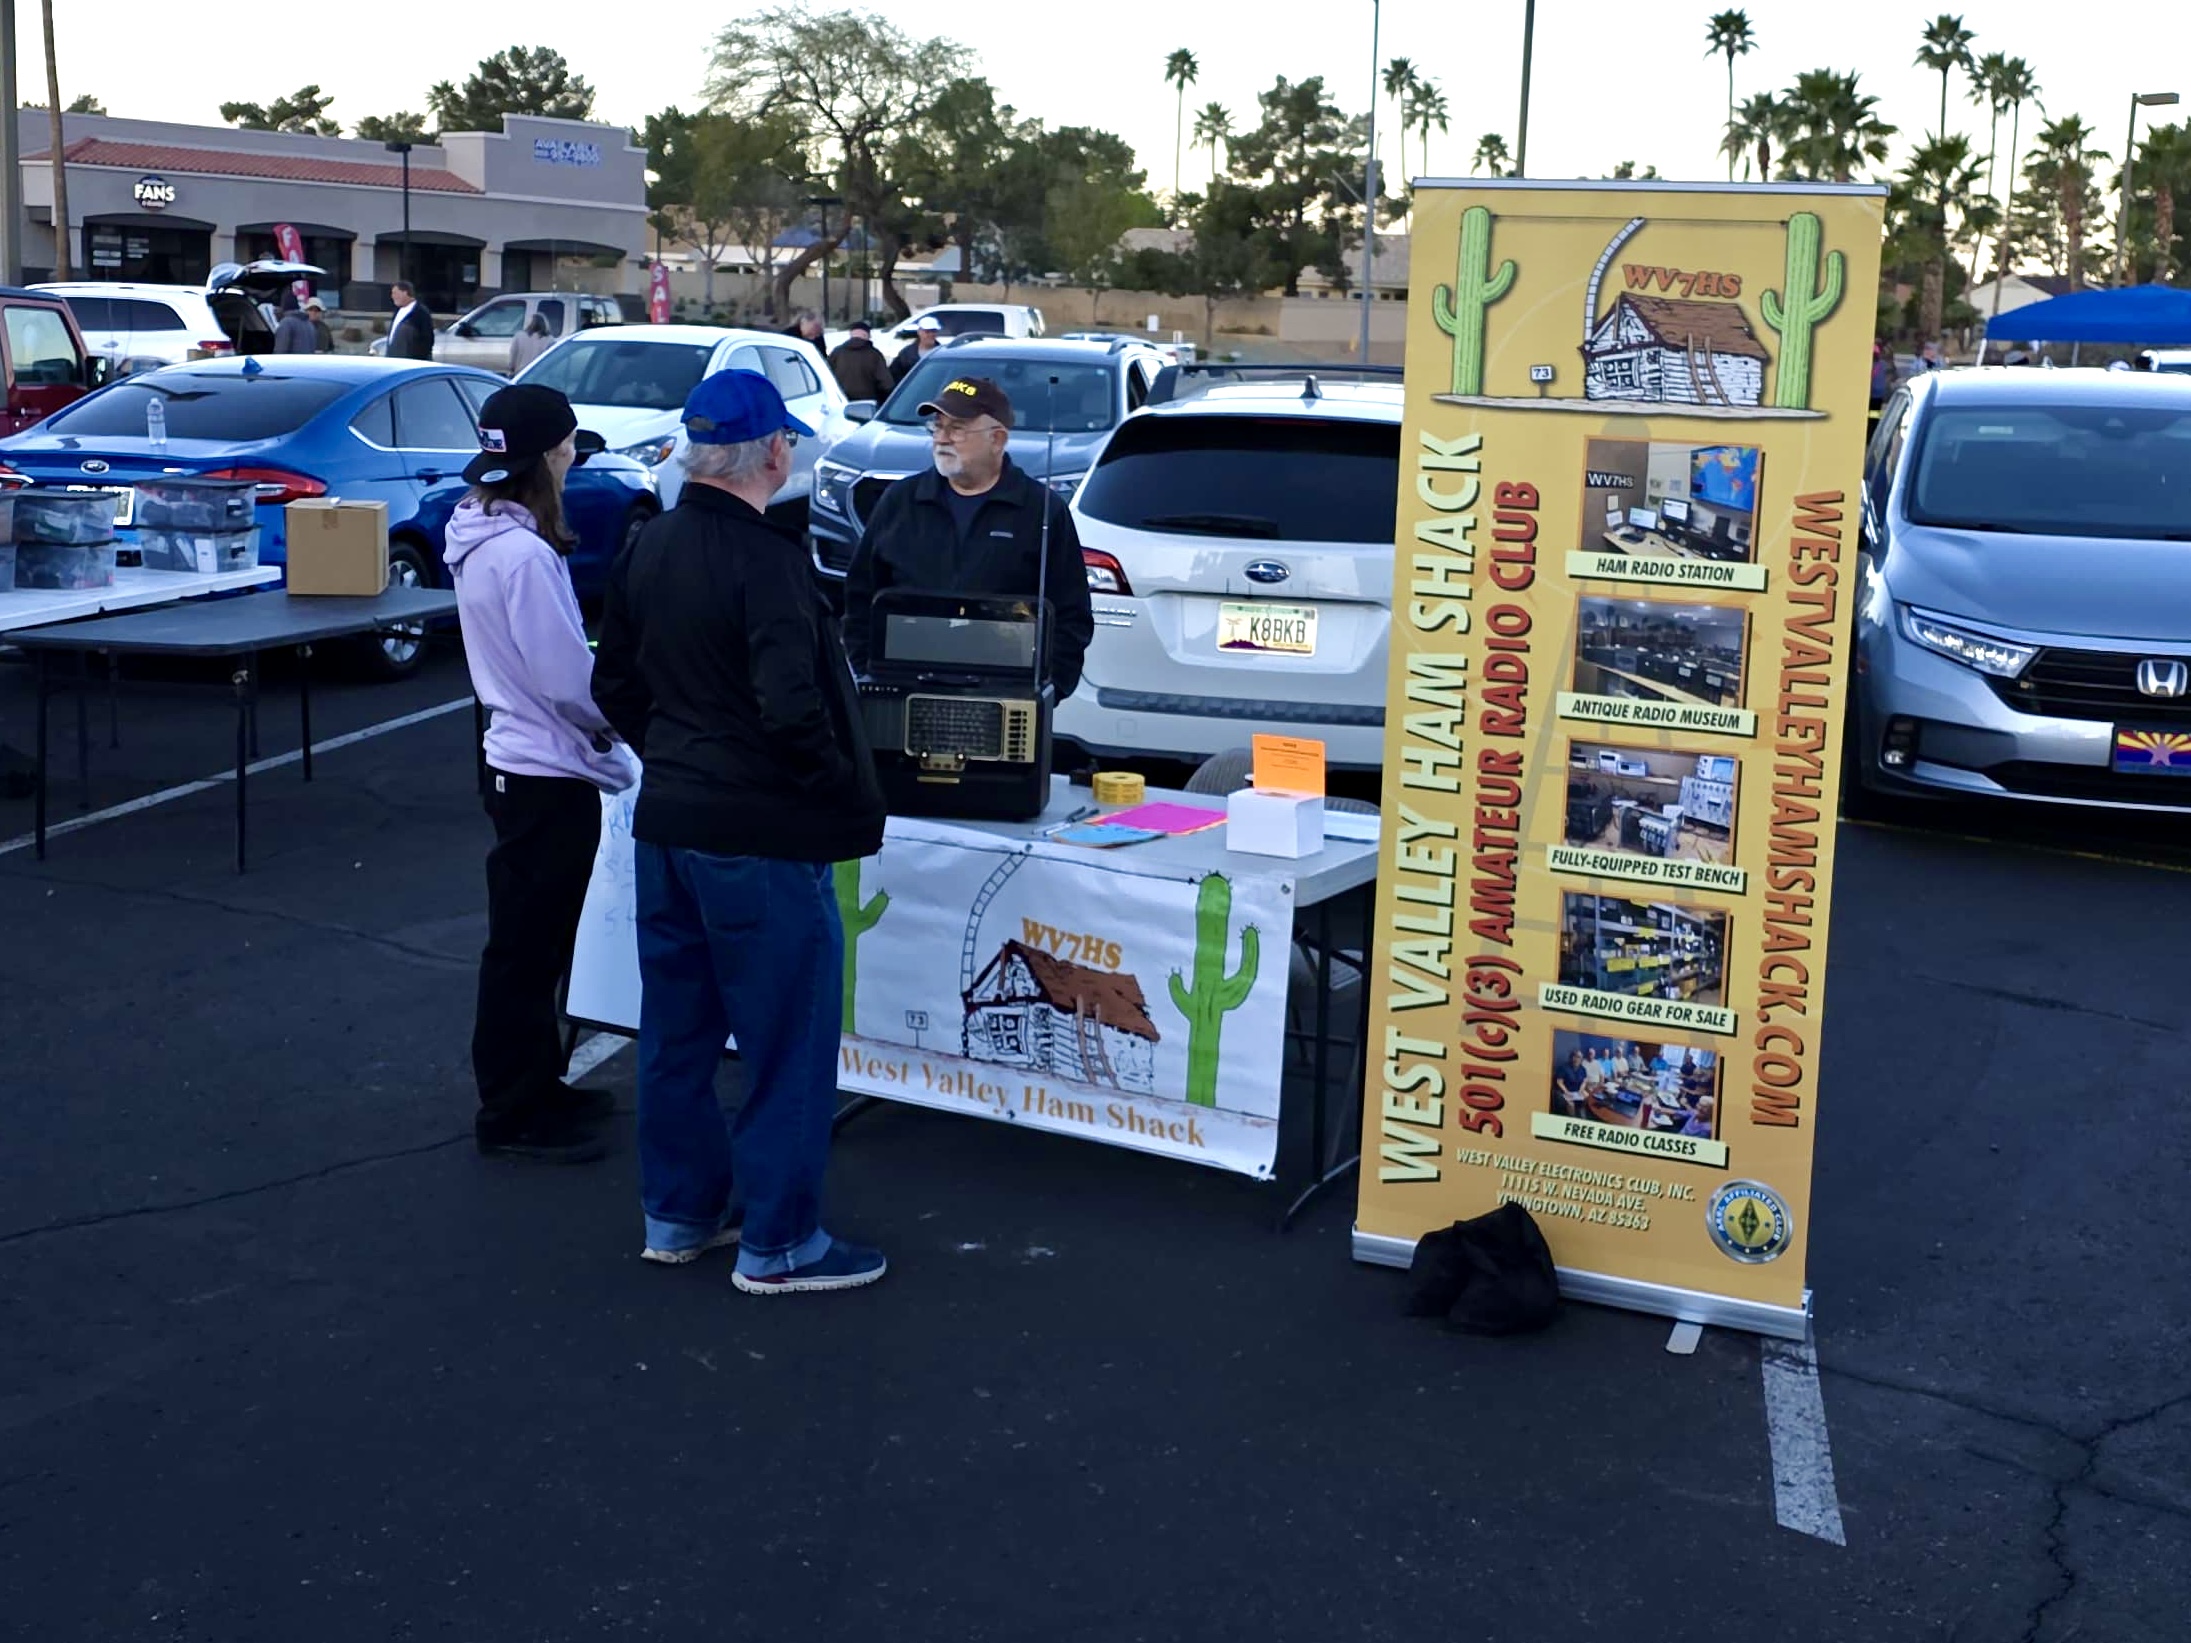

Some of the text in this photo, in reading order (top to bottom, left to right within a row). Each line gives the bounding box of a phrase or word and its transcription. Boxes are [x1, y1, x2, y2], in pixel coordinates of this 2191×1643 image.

[134, 184, 175, 201] FANS
[1622, 264, 1742, 298] WV7HS
[1533, 369, 1549, 379] 73
[1587, 472, 1634, 488] WV7HS
[1596, 558, 1735, 582] HAM RADIO STATION
[1250, 617, 1306, 643] K8BKB
[1571, 699, 1740, 729] ANTIQUE RADIO MUSEUM
[1378, 429, 1483, 1183] WEST VALLEY HAM SHACK
[1458, 481, 1540, 1138] 501(c)(3) AMATEUR RADIO CLUB
[1750, 490, 1845, 1128] WESTVALLEYHAMSHACK.COM
[1551, 850, 1740, 886] FULLY-EQUIPPED TEST BENCH
[1022, 917, 1123, 969] WV7HS
[1545, 988, 1727, 1027] USED RADIO GEAR FOR SALE
[841, 1048, 1206, 1147] West Valley Ham Shack
[1564, 1122, 1698, 1156] FREE RADIO CLASSES
[1456, 1148, 1696, 1201] WEST VALLEY ELECTRONICS CLUB, INC.
[1543, 1181, 1559, 1198] W.
[1561, 1183, 1615, 1207] NEVADA
[1617, 1193, 1647, 1212] AVE.
[1588, 1208, 1607, 1224] AZ
